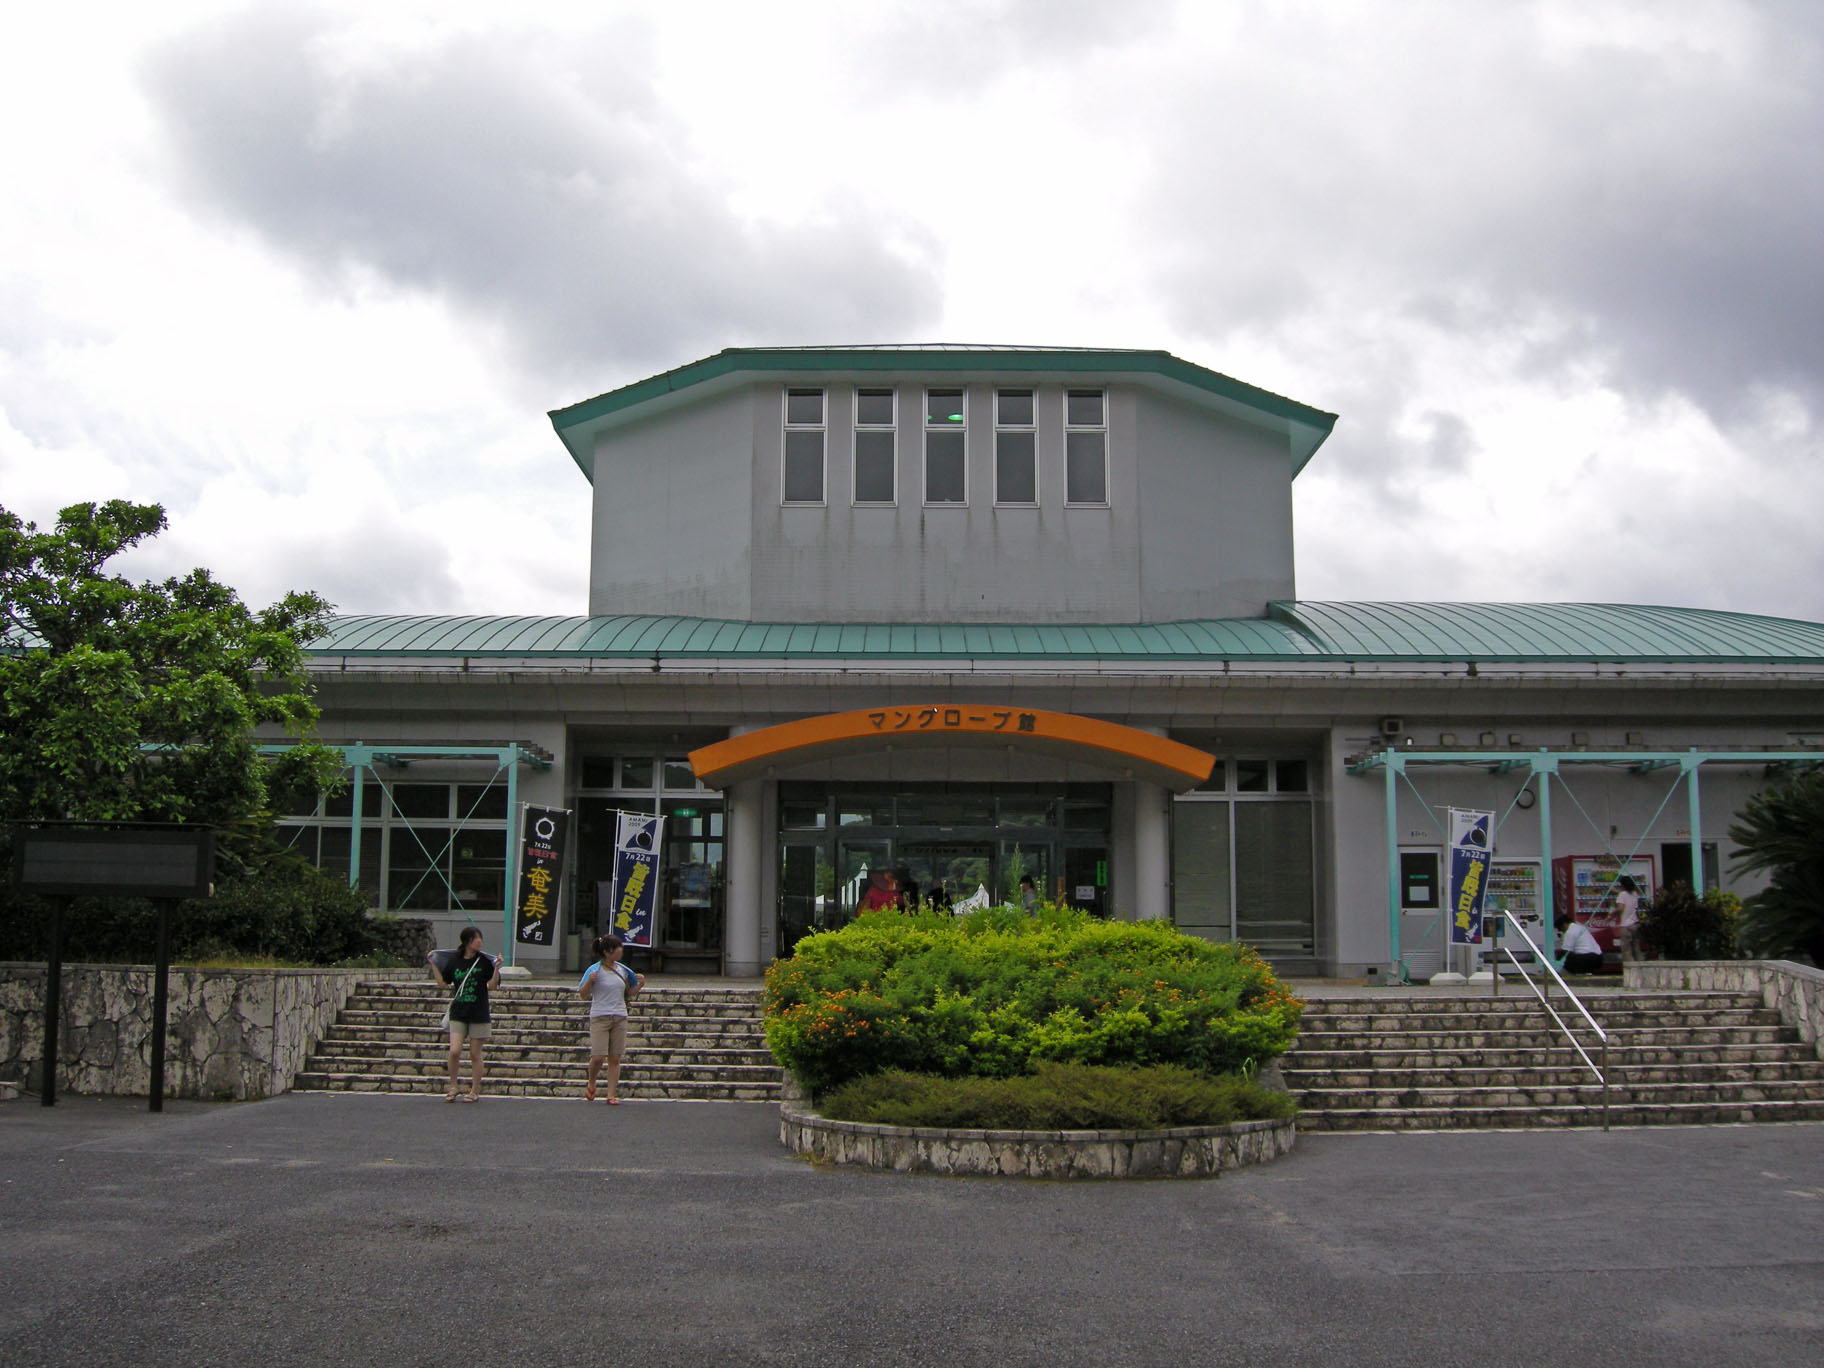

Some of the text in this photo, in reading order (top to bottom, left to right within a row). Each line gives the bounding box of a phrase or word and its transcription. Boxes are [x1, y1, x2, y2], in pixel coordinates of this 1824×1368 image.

[868, 709, 1035, 731] マングローブ館
[523, 867, 552, 919] 奄美
